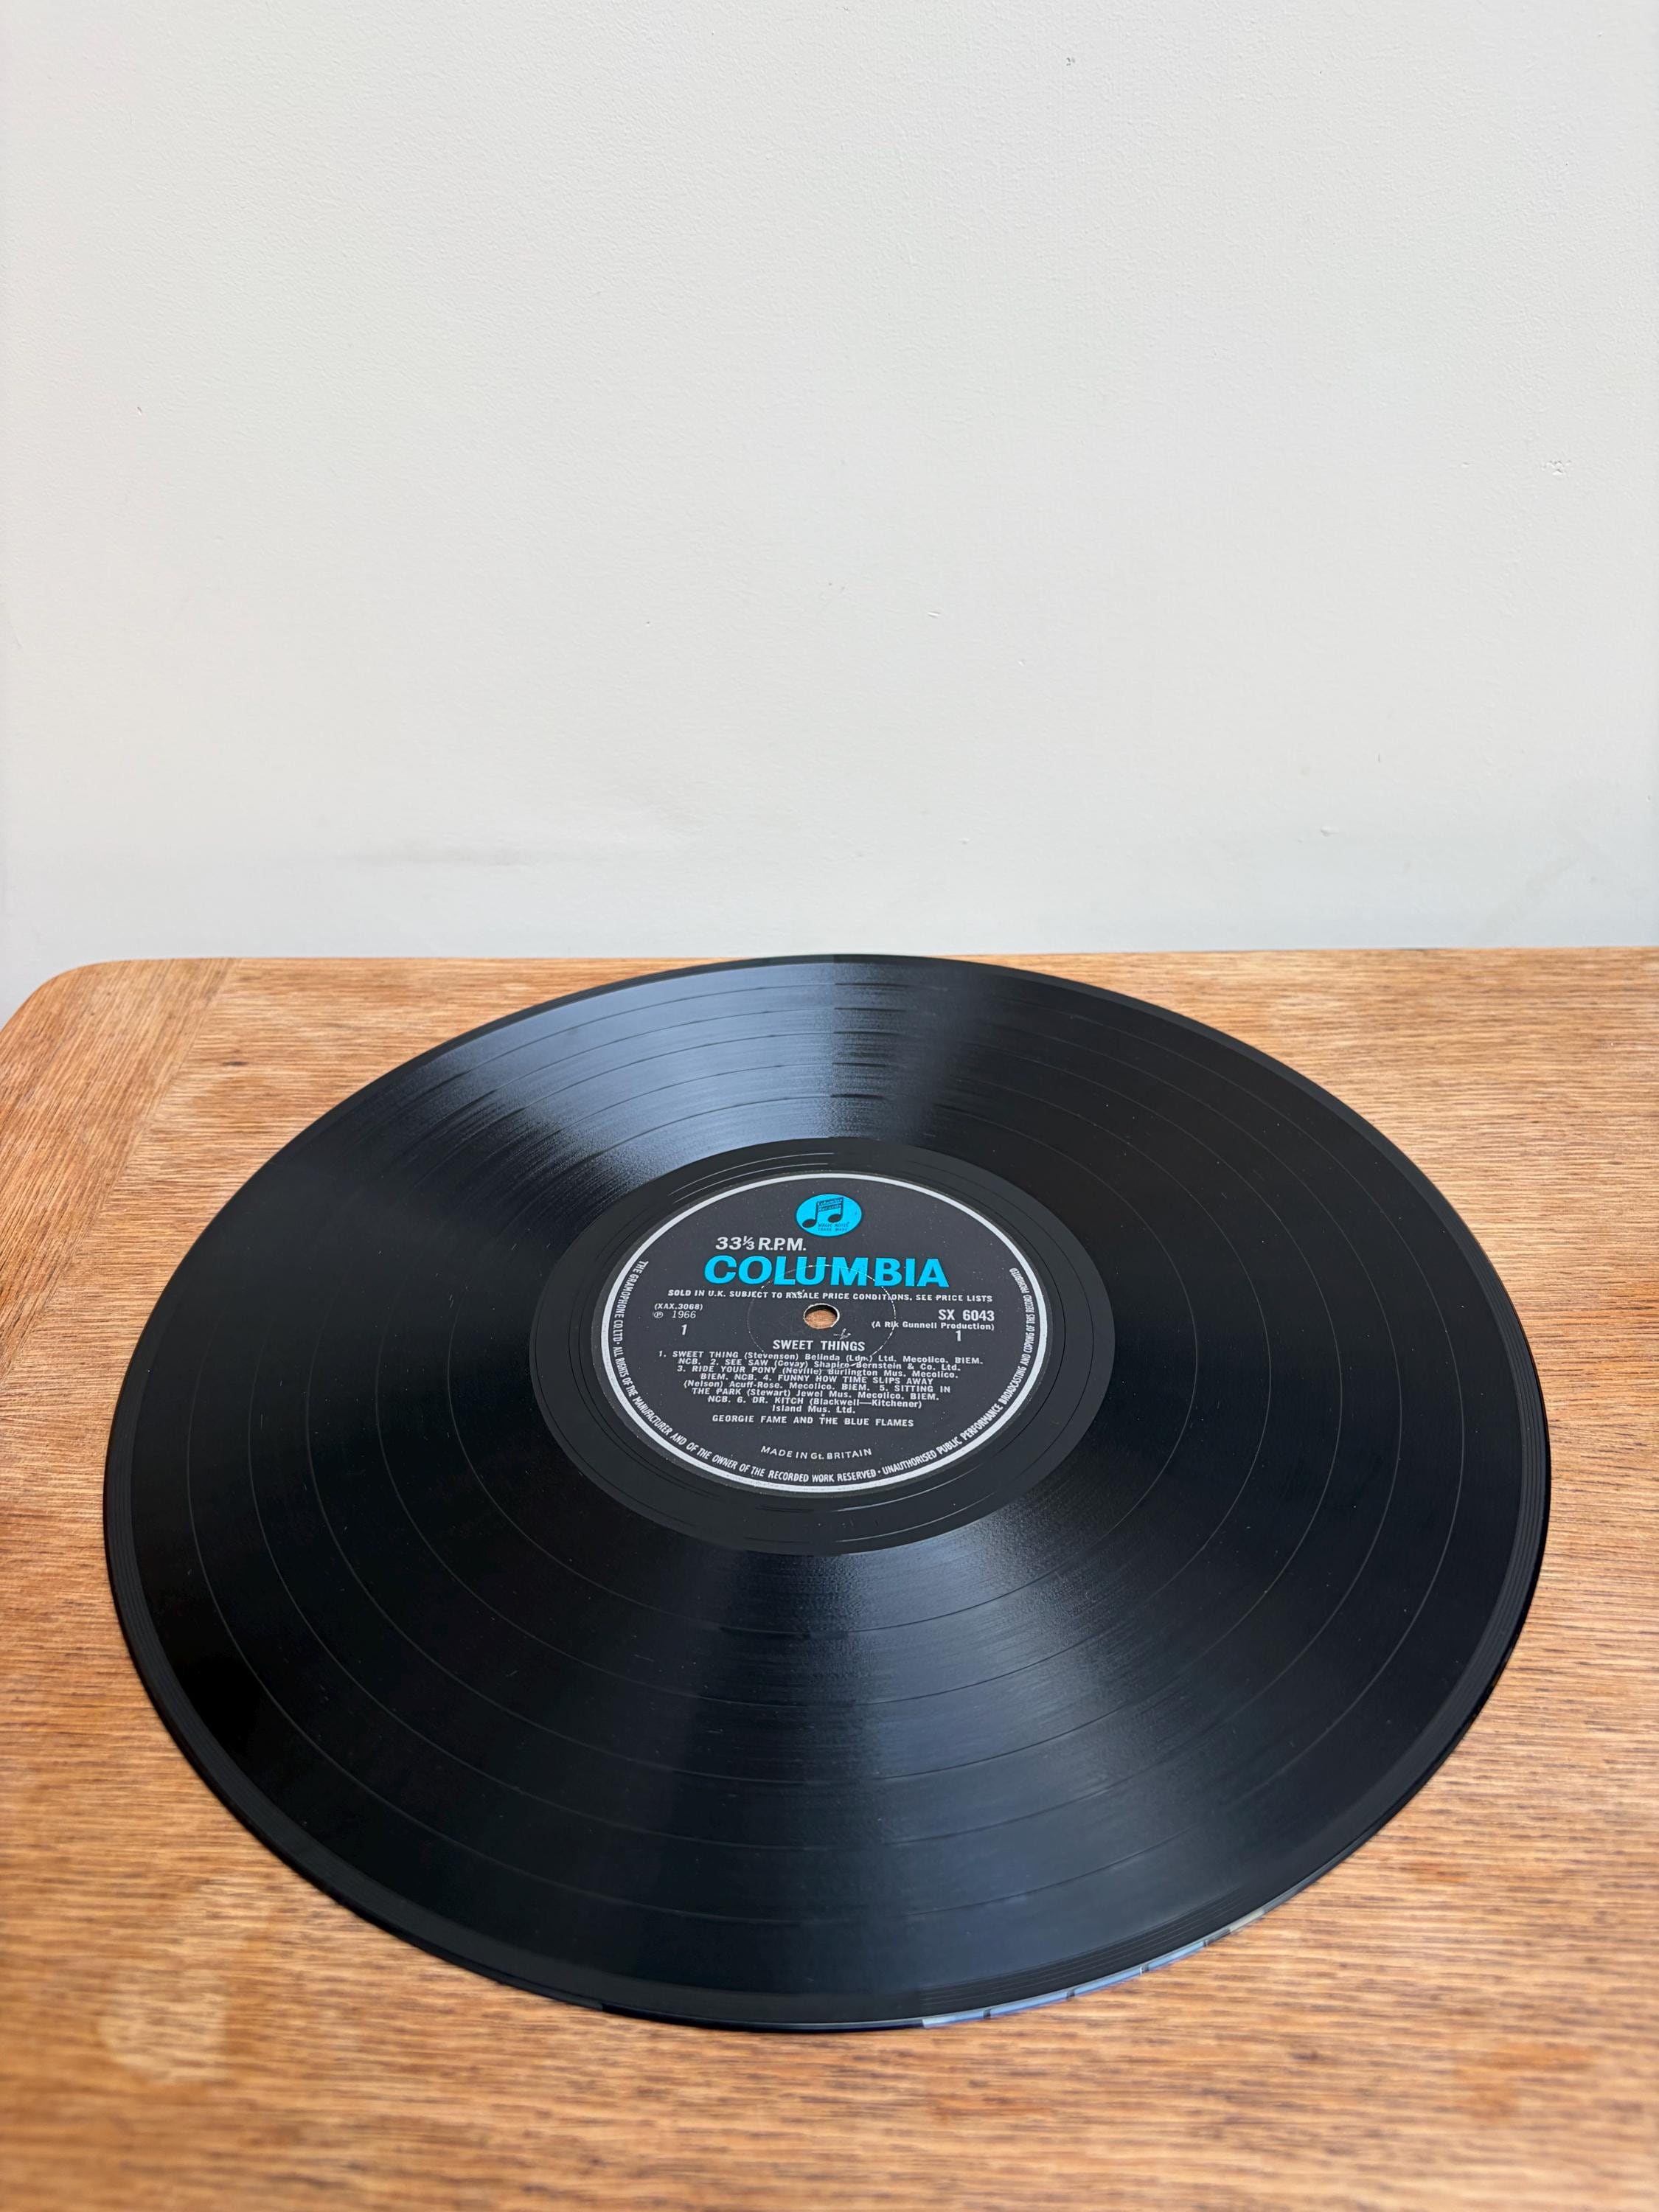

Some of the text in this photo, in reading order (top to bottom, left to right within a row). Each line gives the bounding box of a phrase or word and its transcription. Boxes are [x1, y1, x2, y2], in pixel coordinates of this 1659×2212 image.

[758, 1237, 807, 1251] R.P.M.
[632, 1260, 649, 1274] THE
[704, 1255, 950, 1287] COLUMBIA
[614, 1273, 639, 1318] GRAMOPHONE
[729, 1290, 768, 1298] SUBJECT
[786, 1291, 819, 1299] RESALE
[654, 1303, 703, 1311] (XAX.3068)
[672, 1310, 697, 1319] 1966
[938, 1309, 995, 1321] SX 6043
[681, 1324, 688, 1335] 1
[872, 1321, 881, 1329] (A
[902, 1321, 937, 1329] Gunnell
[940, 1322, 995, 1332] Production)
[956, 1330, 961, 1342] 1
[772, 1340, 866, 1352] SWEET THINGS
[744, 1352, 799, 1361] (Stevenson)
[902, 1355, 948, 1363] Mecolico.
[774, 1360, 808, 1369] (Covay)
[814, 1361, 849, 1369] Shapiro
[782, 1367, 822, 1376] (Neville)
[828, 1368, 877, 1377] Burlington
[882, 1267, 1035, 1475] UNAUTHORISED PUBLIC PERFORMANCE BROADCASTING AND COPYING OF THIS RECORD PROHIBITED
[684, 1380, 723, 1388] (Nelson)
[894, 1385, 933, 1393] SITTING
[746, 1388, 790, 1397] (Stewart)
[858, 1391, 904, 1399] Mecolico.
[613, 1346, 876, 1483] ALL RIGHTS OF THE MANUFACTURER AND OF THE OWNER OF THE RECORDED WORK RESERVED
[712, 1414, 914, 1427] GEORGIE FAME AND THE BLUE FLAMES
[760, 1445, 872, 1460] MADE IN Gt. BRITAIN
